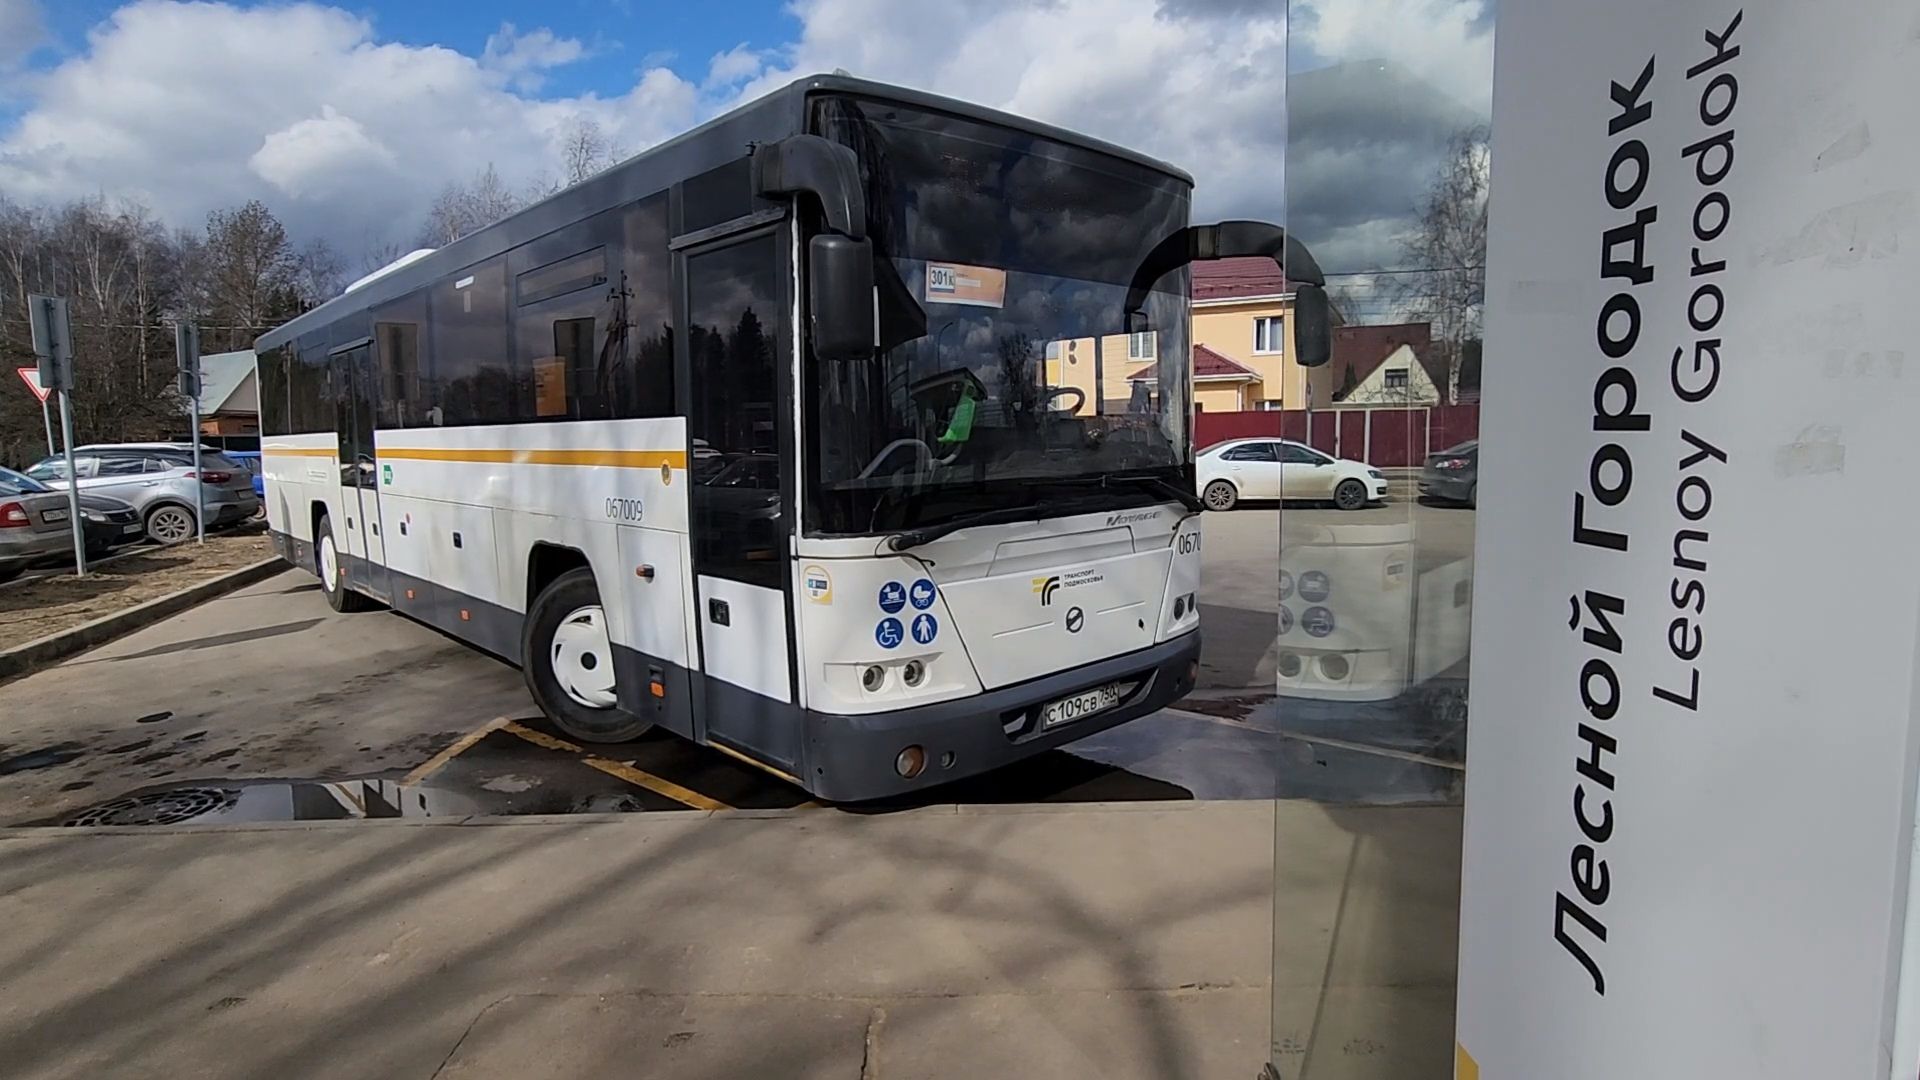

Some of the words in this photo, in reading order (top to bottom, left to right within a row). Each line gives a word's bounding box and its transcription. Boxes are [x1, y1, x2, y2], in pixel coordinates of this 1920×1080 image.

[1573, 53, 1658, 551] Городок
[1671, 8, 1743, 402] Gorodok
[605, 497, 643, 521] 067009
[1652, 429, 1728, 711] Lesnoy
[1554, 590, 1625, 997] Лесной
